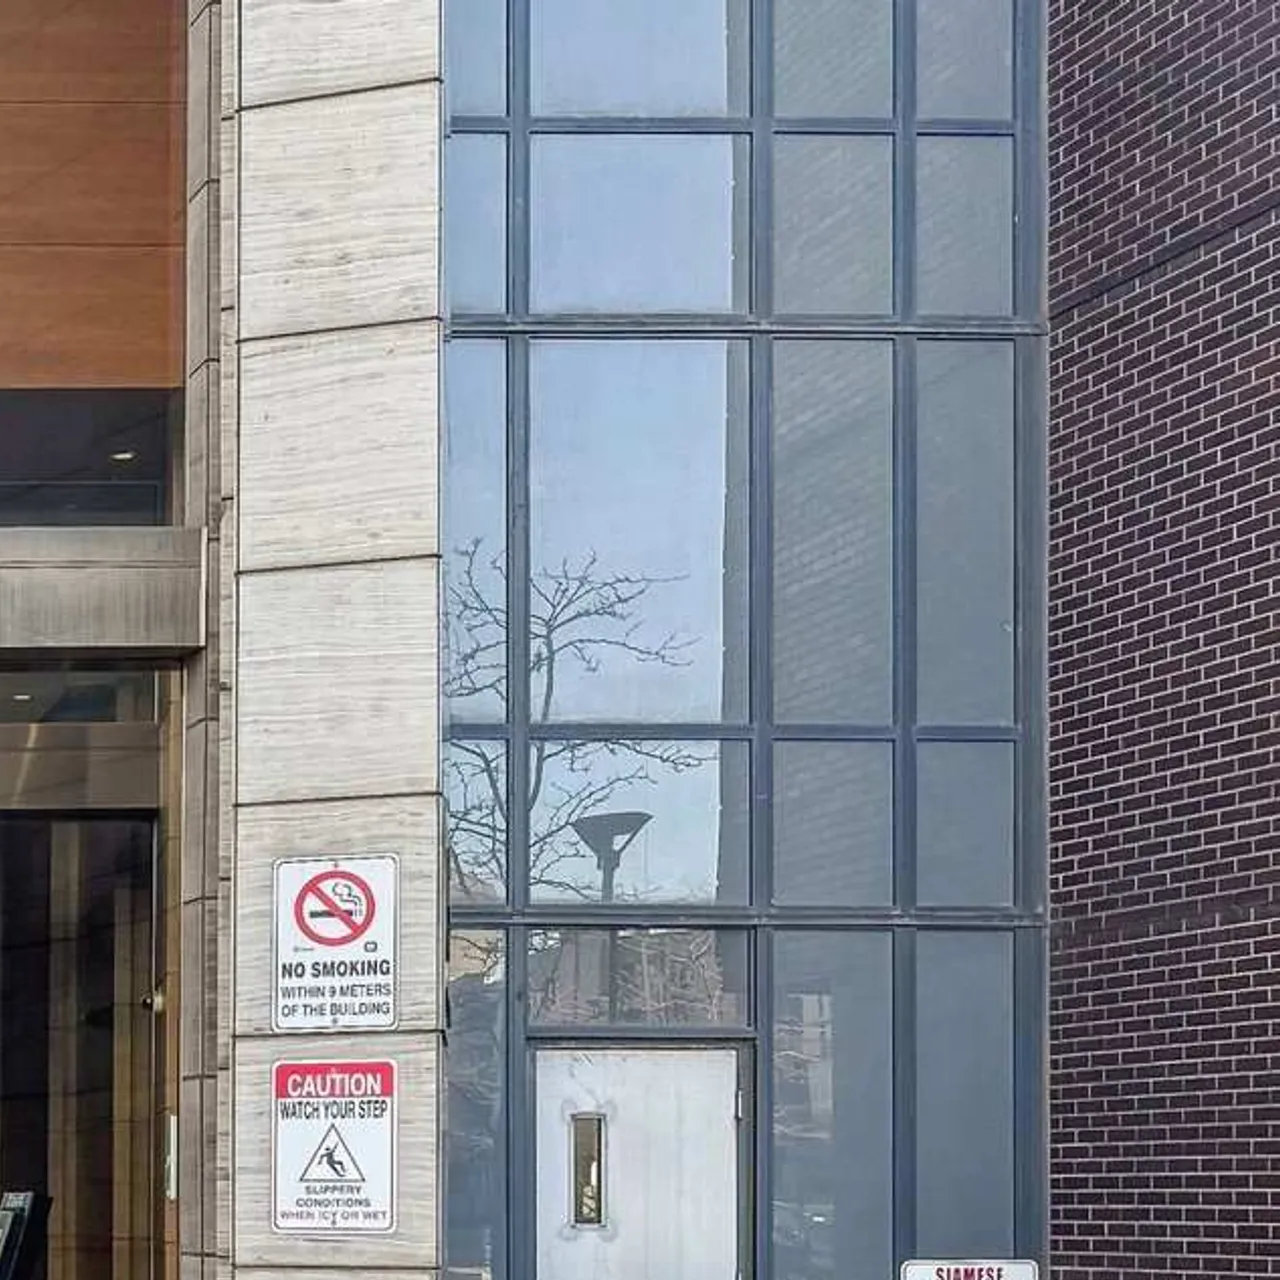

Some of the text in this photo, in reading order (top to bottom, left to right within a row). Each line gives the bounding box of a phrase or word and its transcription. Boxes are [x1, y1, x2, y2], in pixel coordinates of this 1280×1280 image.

[281, 959, 390, 979] NO SMOKING
[280, 983, 391, 999] WITHIN 9 METERS
[281, 1001, 390, 1018] OF THE BUILDING
[287, 1073, 382, 1096] CAUTION
[280, 1100, 388, 1120] WATCH YOUR STEP
[304, 1184, 362, 1195] SLIPPERY
[296, 1197, 371, 1208] CONDITIONS
